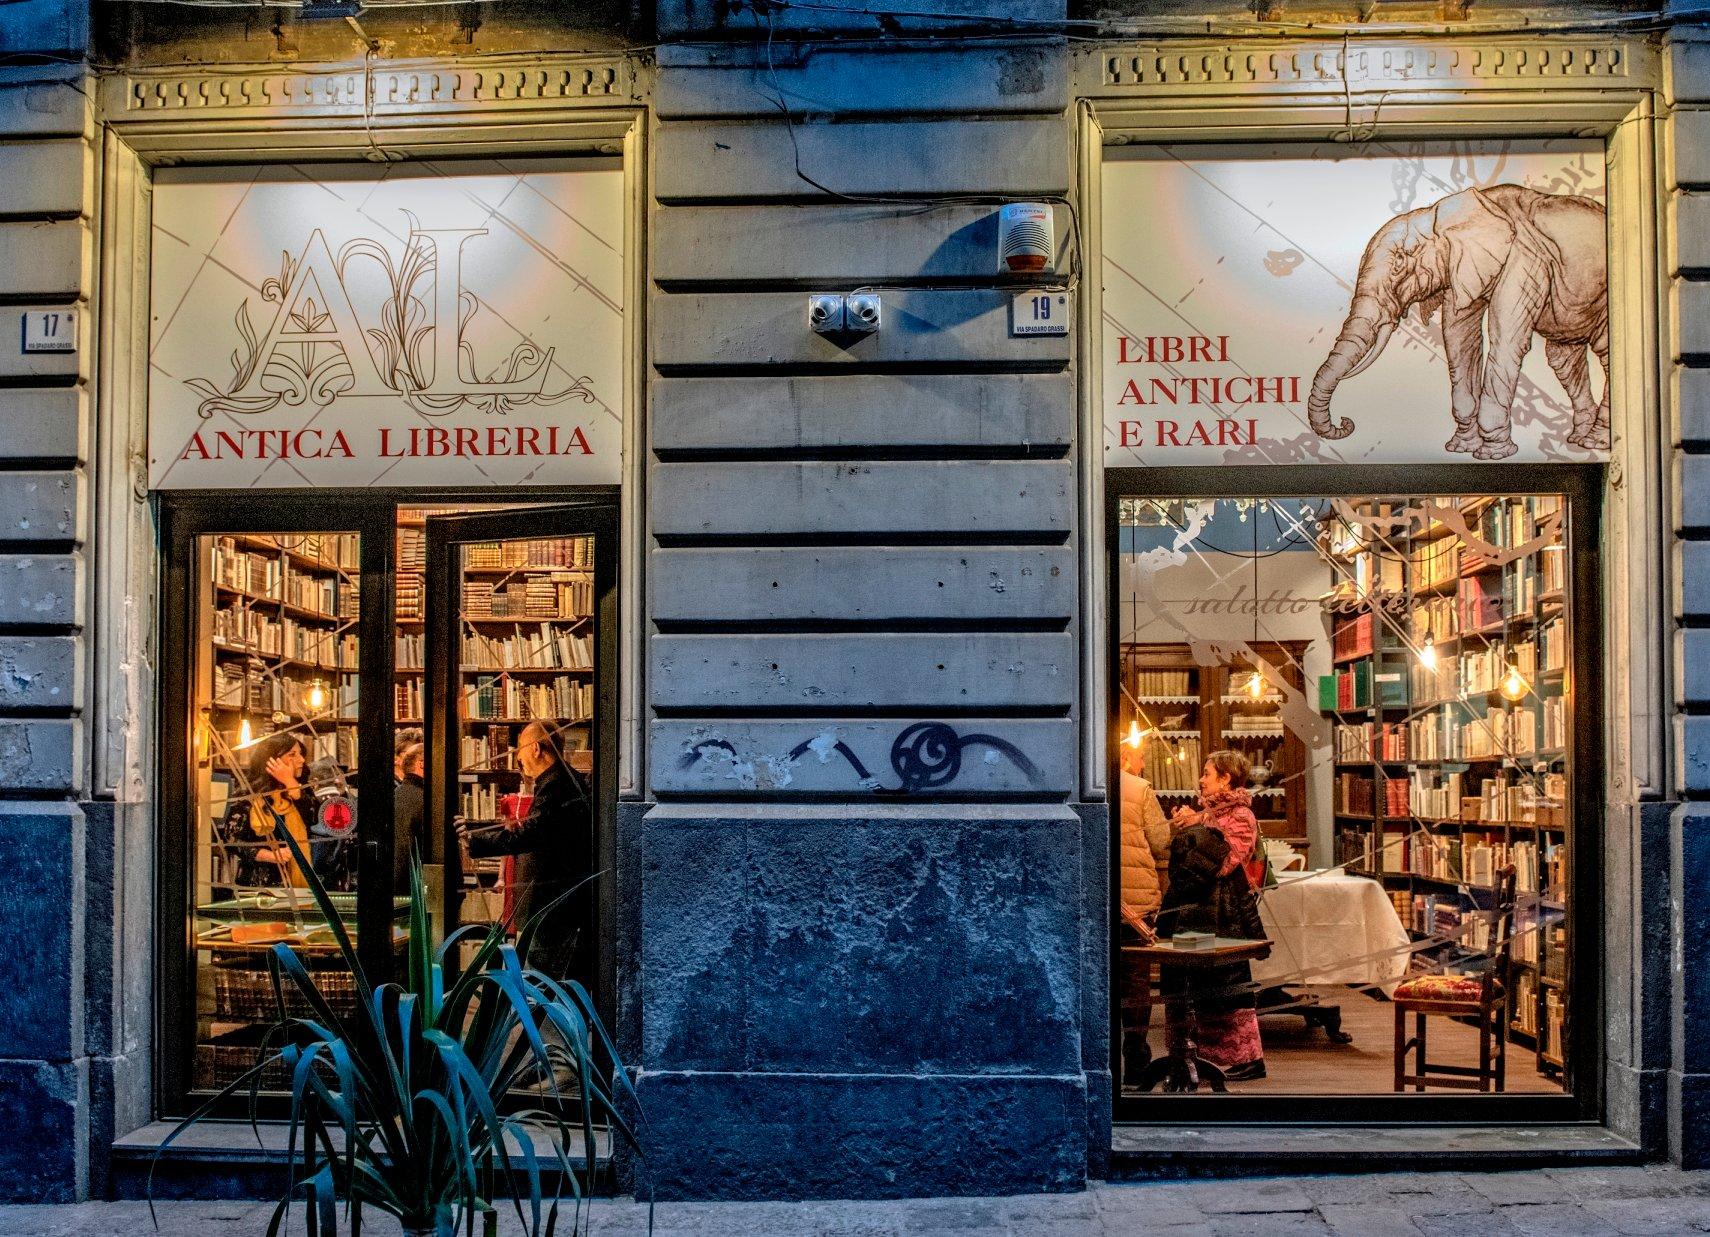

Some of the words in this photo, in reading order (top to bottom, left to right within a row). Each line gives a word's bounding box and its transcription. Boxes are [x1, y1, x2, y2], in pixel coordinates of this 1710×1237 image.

[1031, 296, 1051, 320] 19
[43, 314, 59, 337] 17
[1116, 335, 1231, 365] LIBRI
[1117, 375, 1302, 406] ANTICHI
[182, 427, 355, 461] ANTICA
[378, 425, 597, 459] LIBRERIA
[1118, 419, 1144, 448] E
[1155, 418, 1259, 447] RARI
